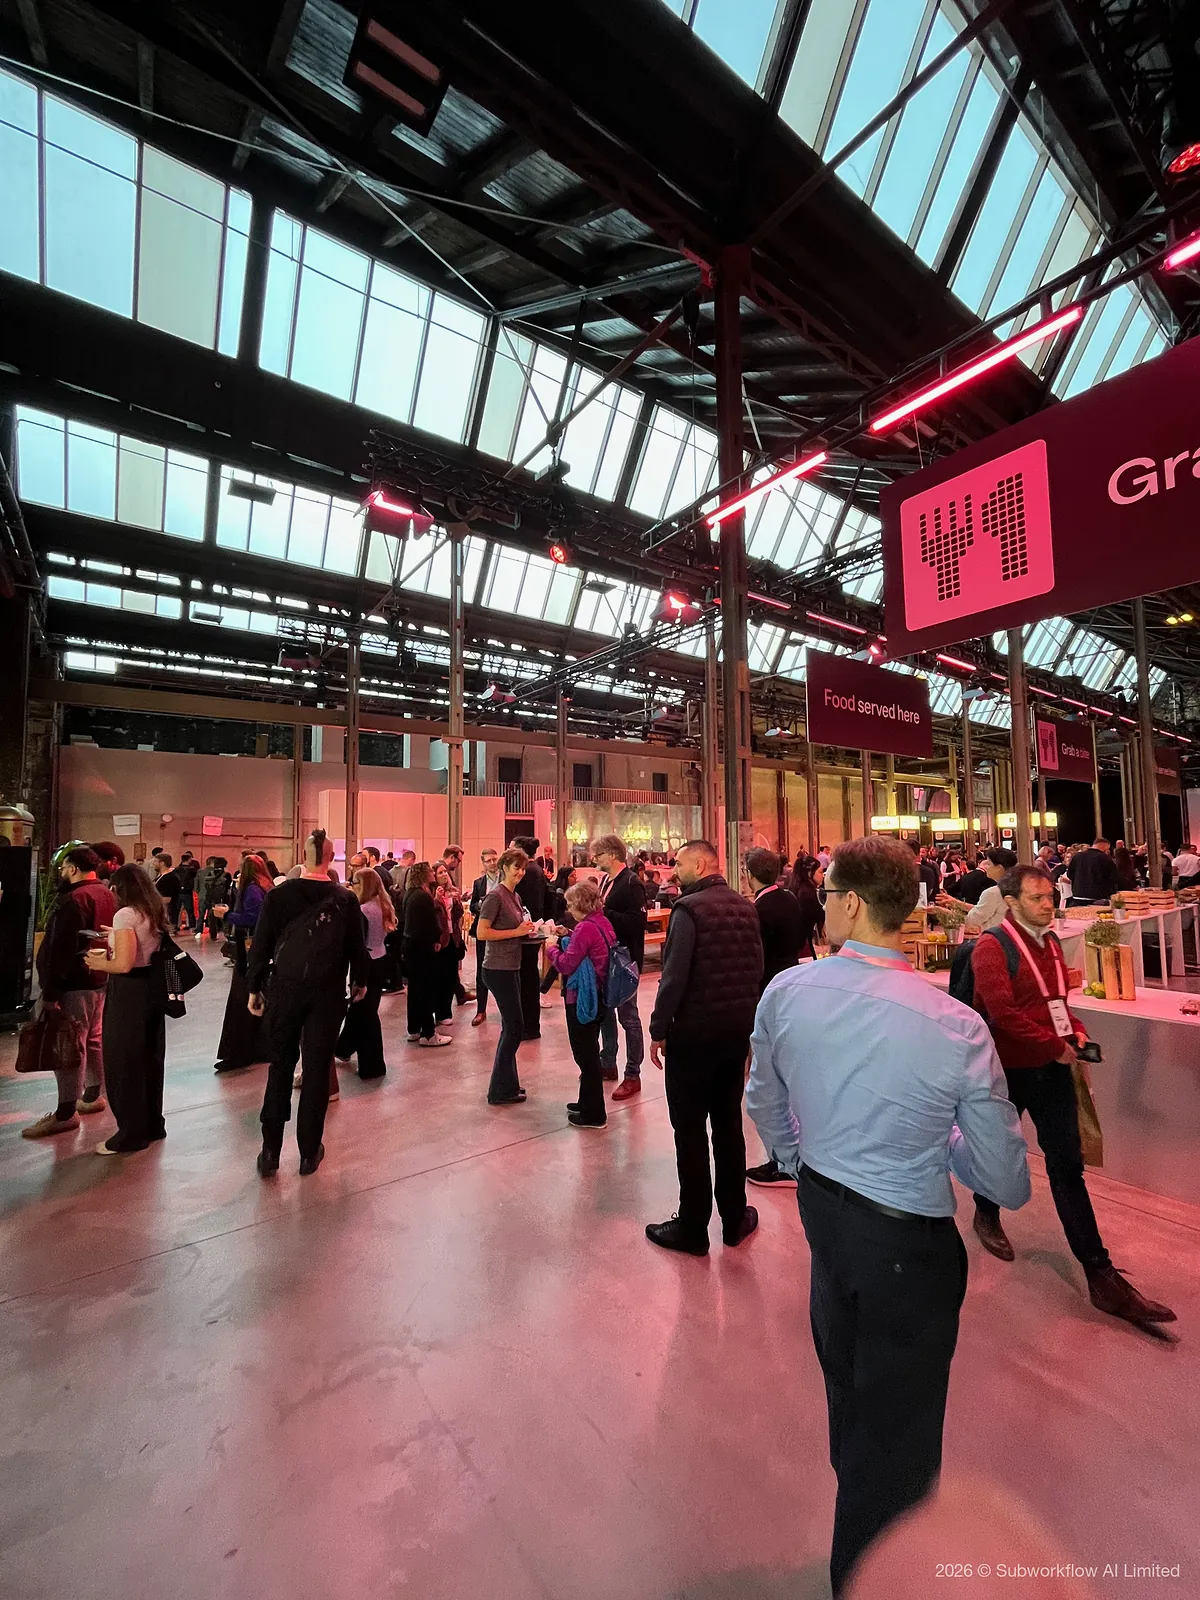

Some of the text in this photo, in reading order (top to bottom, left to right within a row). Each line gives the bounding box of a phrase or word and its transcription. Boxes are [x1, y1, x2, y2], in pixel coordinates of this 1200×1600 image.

[824, 688, 920, 724] Food served here
[1061, 742, 1076, 757] Grab
[1076, 748, 1080, 758] a
